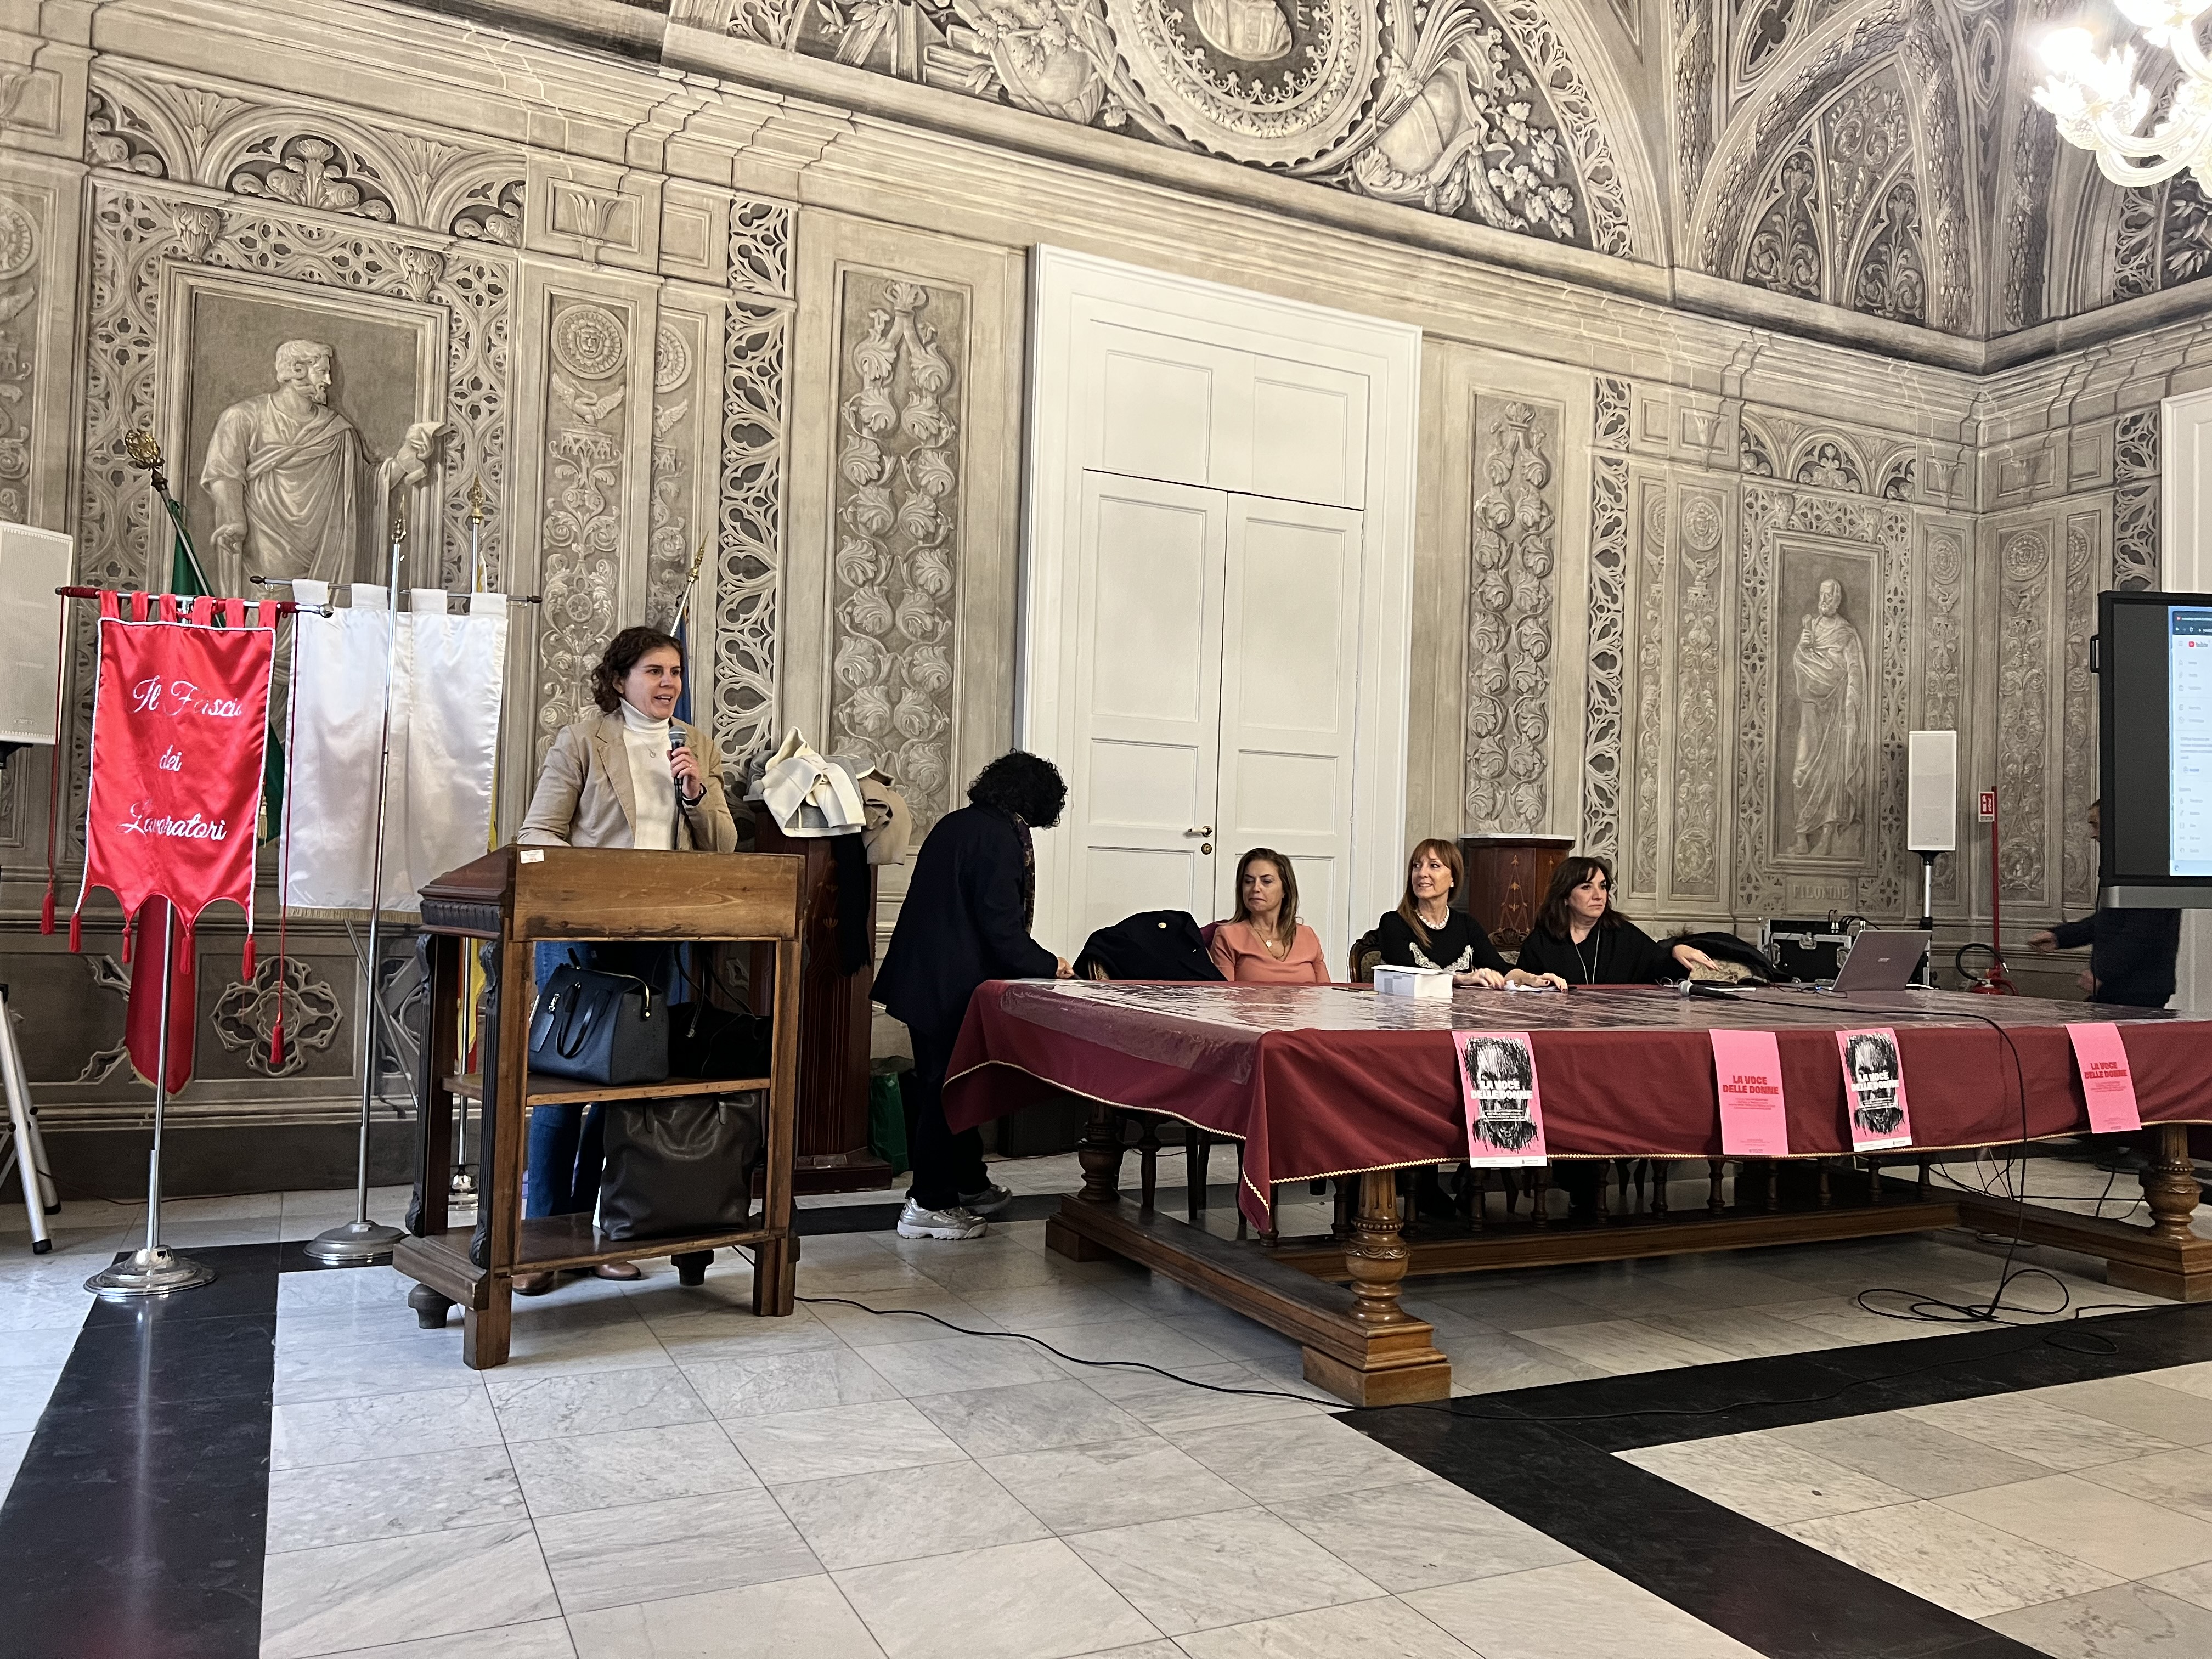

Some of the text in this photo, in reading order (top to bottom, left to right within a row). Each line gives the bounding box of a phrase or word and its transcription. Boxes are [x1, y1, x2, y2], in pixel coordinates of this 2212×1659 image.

[133, 675, 162, 713] Il
[159, 744, 182, 771] dei
[115, 798, 227, 840] Lavoratori
[1733, 1075, 1767, 1085] LA VOCE
[1859, 1071, 1889, 1082] LA VOCE
[1481, 1080, 1520, 1090] LA VOCE
[1723, 1084, 1779, 1094] DELLE DONNE
[1851, 1082, 1874, 1092] DELLE
[1470, 1090, 1533, 1099] DELLE DONNE
